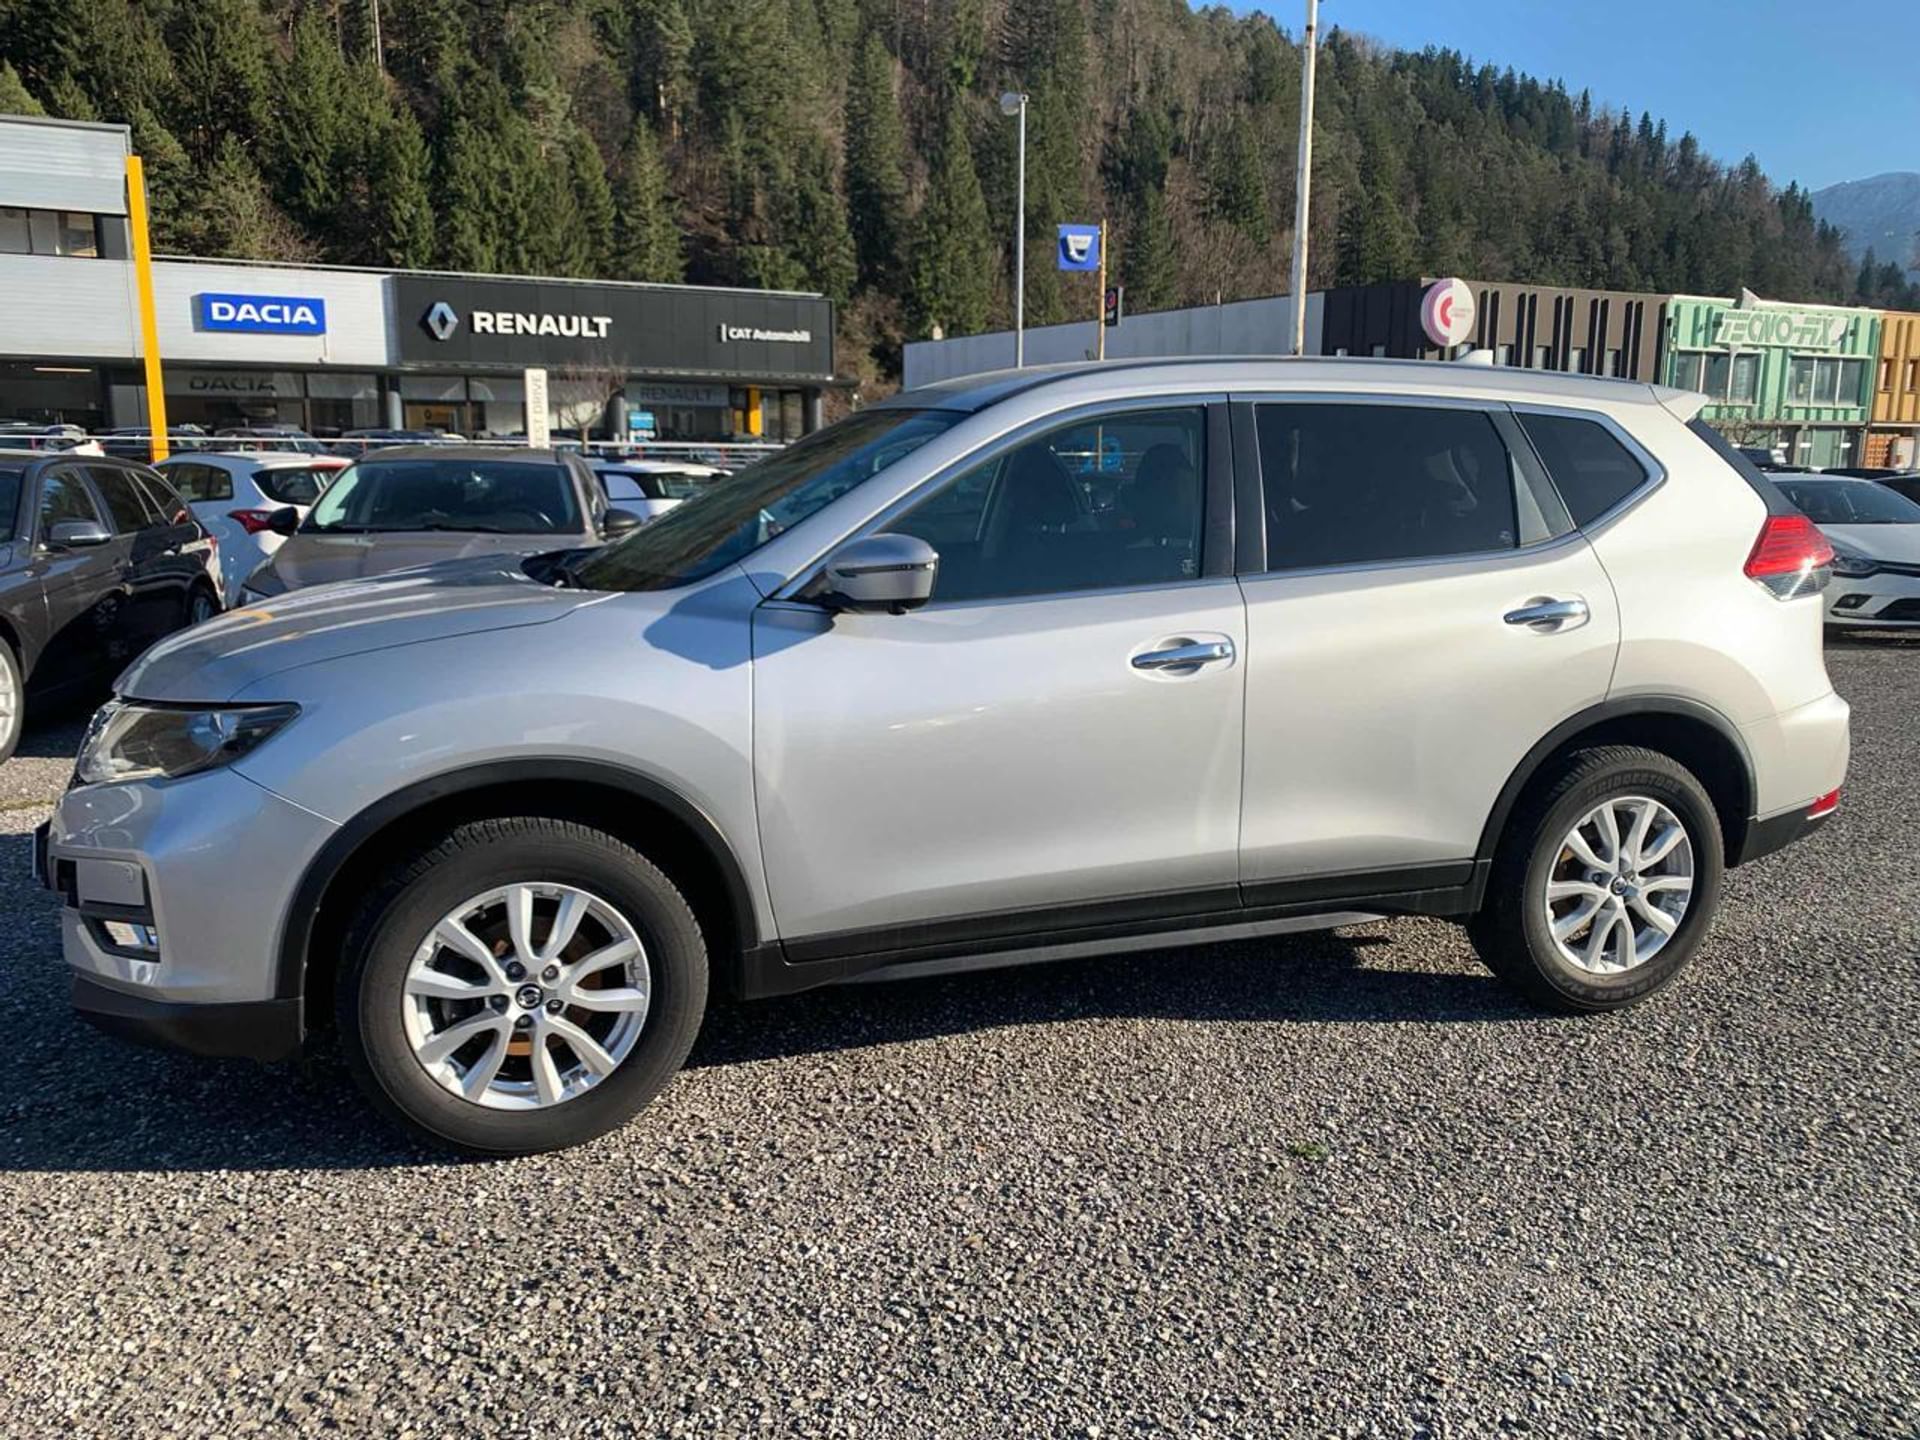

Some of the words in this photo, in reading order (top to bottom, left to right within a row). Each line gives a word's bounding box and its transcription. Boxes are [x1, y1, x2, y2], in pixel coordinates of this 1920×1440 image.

[211, 302, 317, 325] DACIA
[472, 311, 613, 338] RENAULT
[729, 327, 753, 340] CAT
[753, 328, 812, 343] Automobili
[1720, 311, 1836, 346] TECNO-FIX
[189, 376, 277, 392] DACIA
[530, 373, 544, 415] DRIVE
[640, 386, 712, 401] RENAULT
